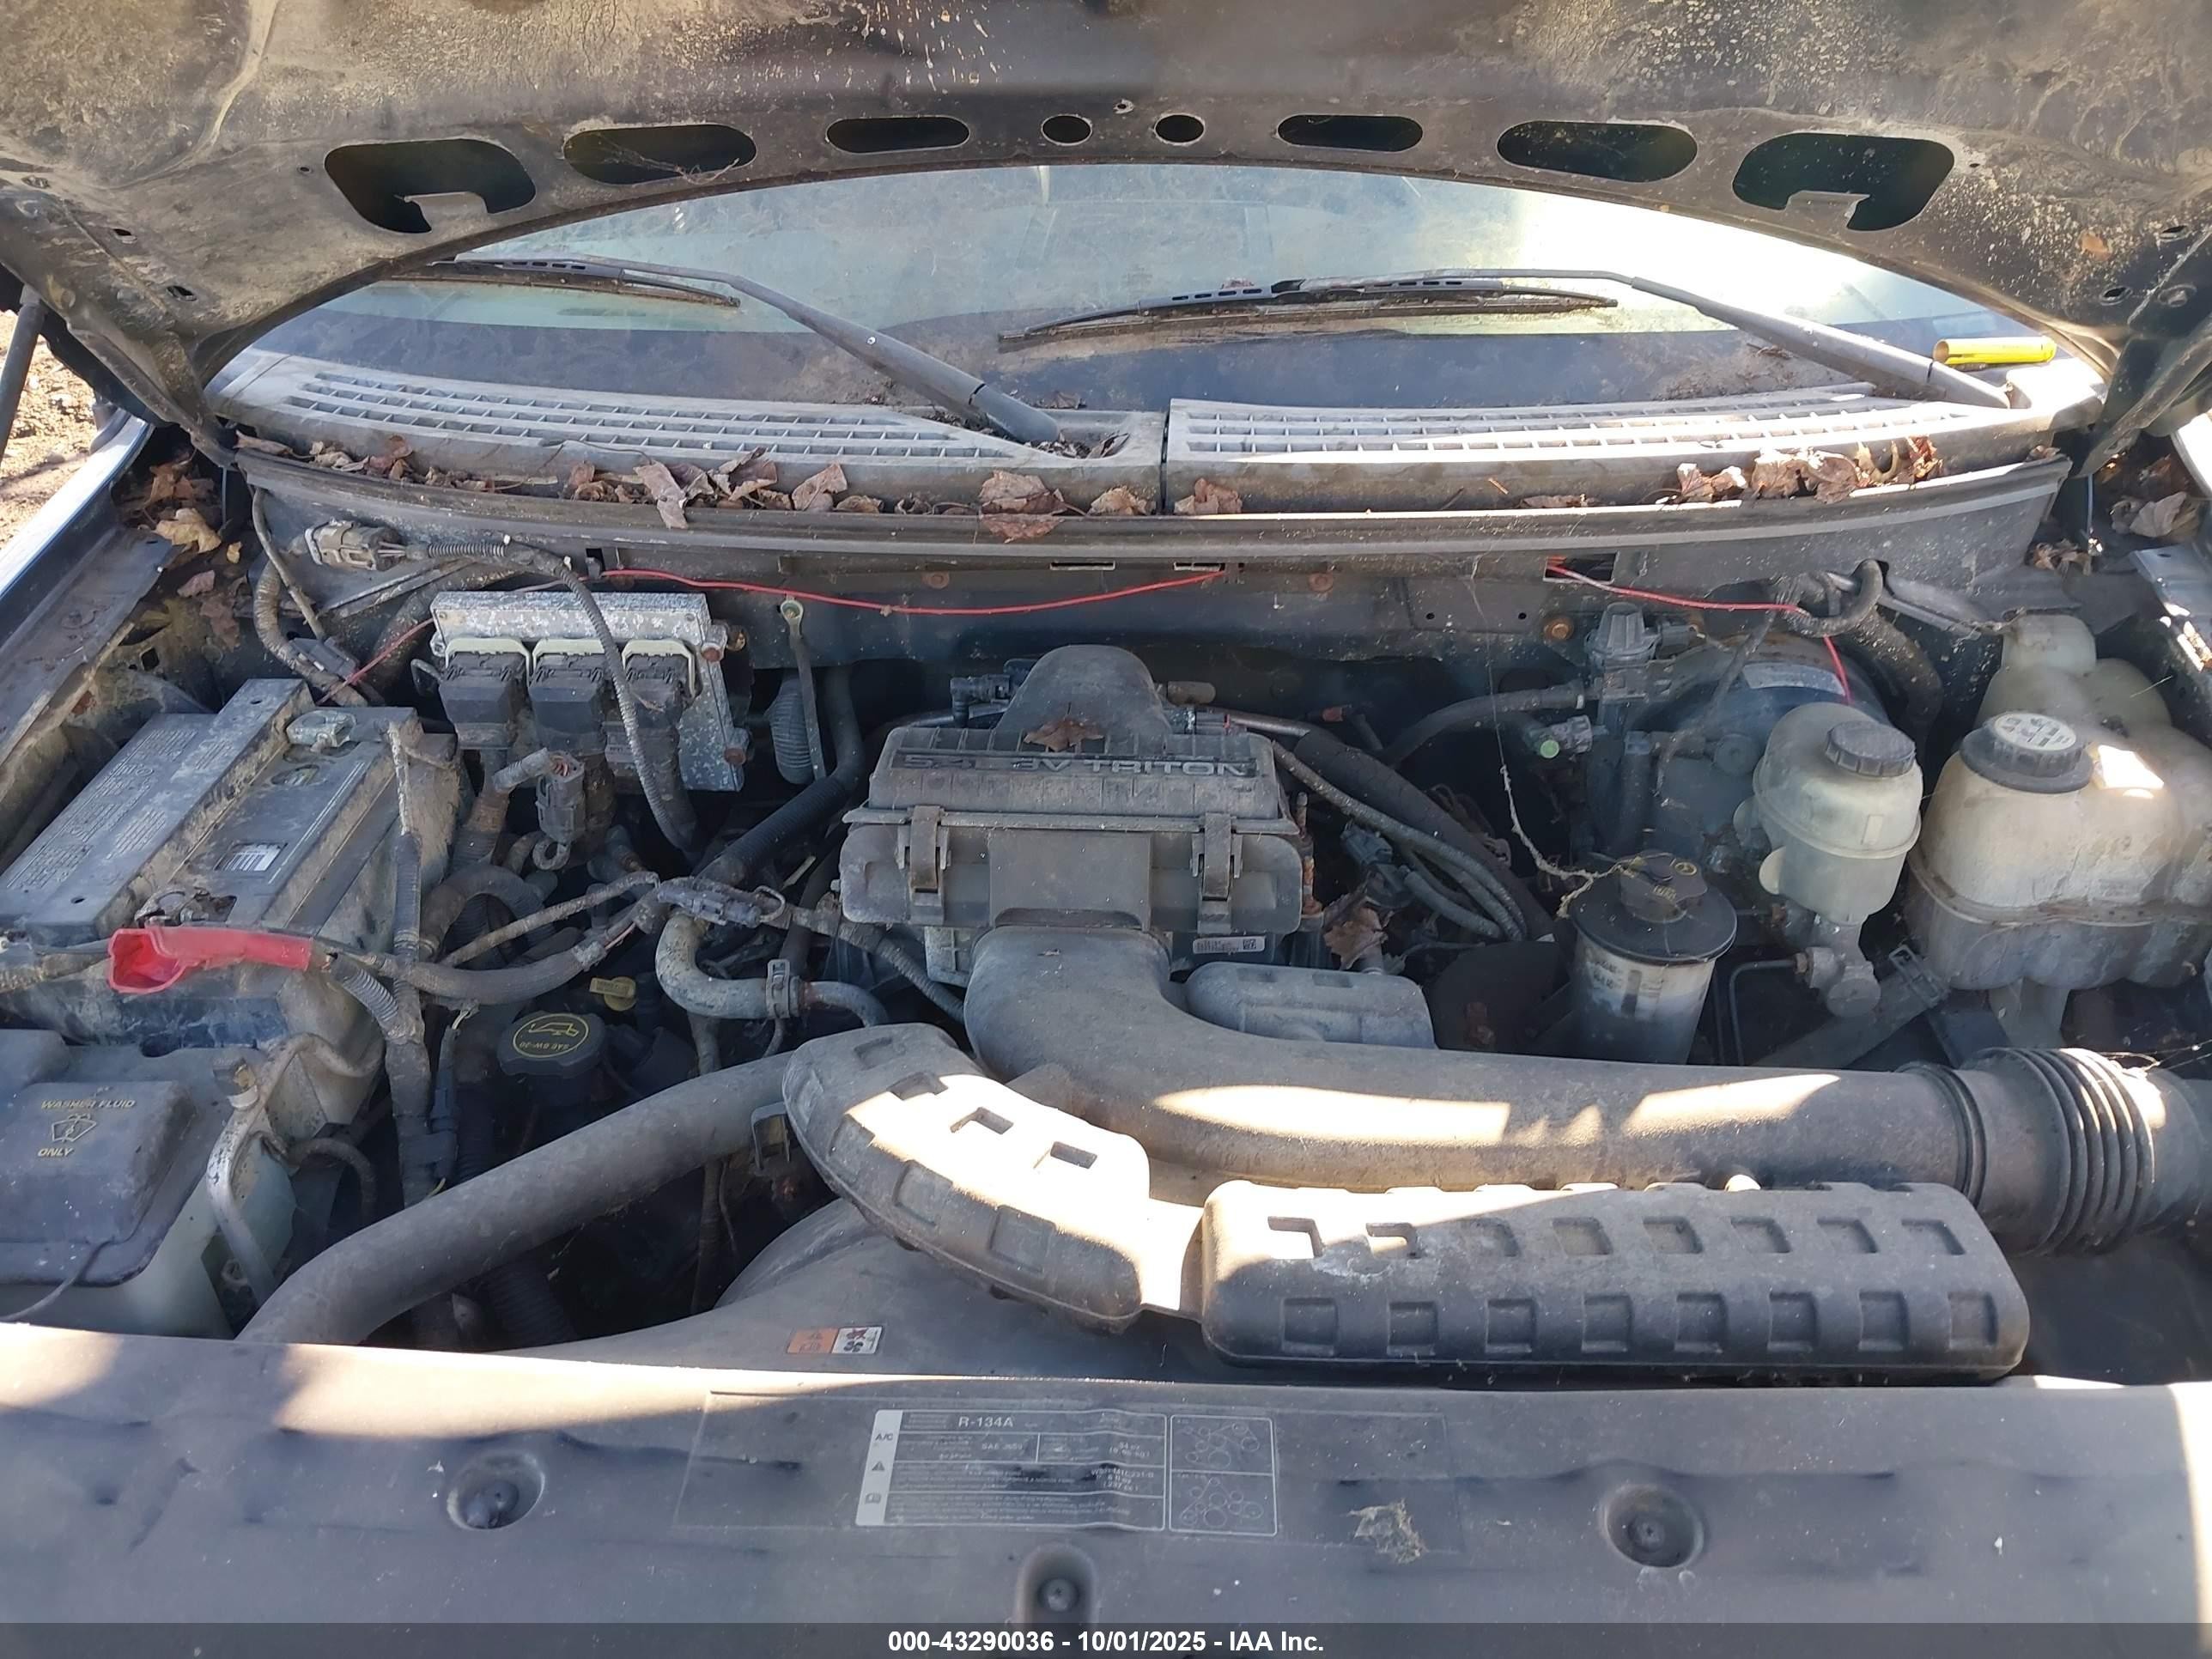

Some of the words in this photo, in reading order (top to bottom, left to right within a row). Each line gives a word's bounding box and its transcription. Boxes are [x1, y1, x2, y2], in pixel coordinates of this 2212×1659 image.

[1012, 757, 1072, 772] 3V
[1083, 759, 1253, 778] TRITON
[41, 1098, 95, 1109] WASHER
[98, 1099, 137, 1109] FLUID
[37, 1147, 74, 1158] ONLY
[957, 1416, 1014, 1428] R-134A
[874, 1432, 895, 1442] A/C
